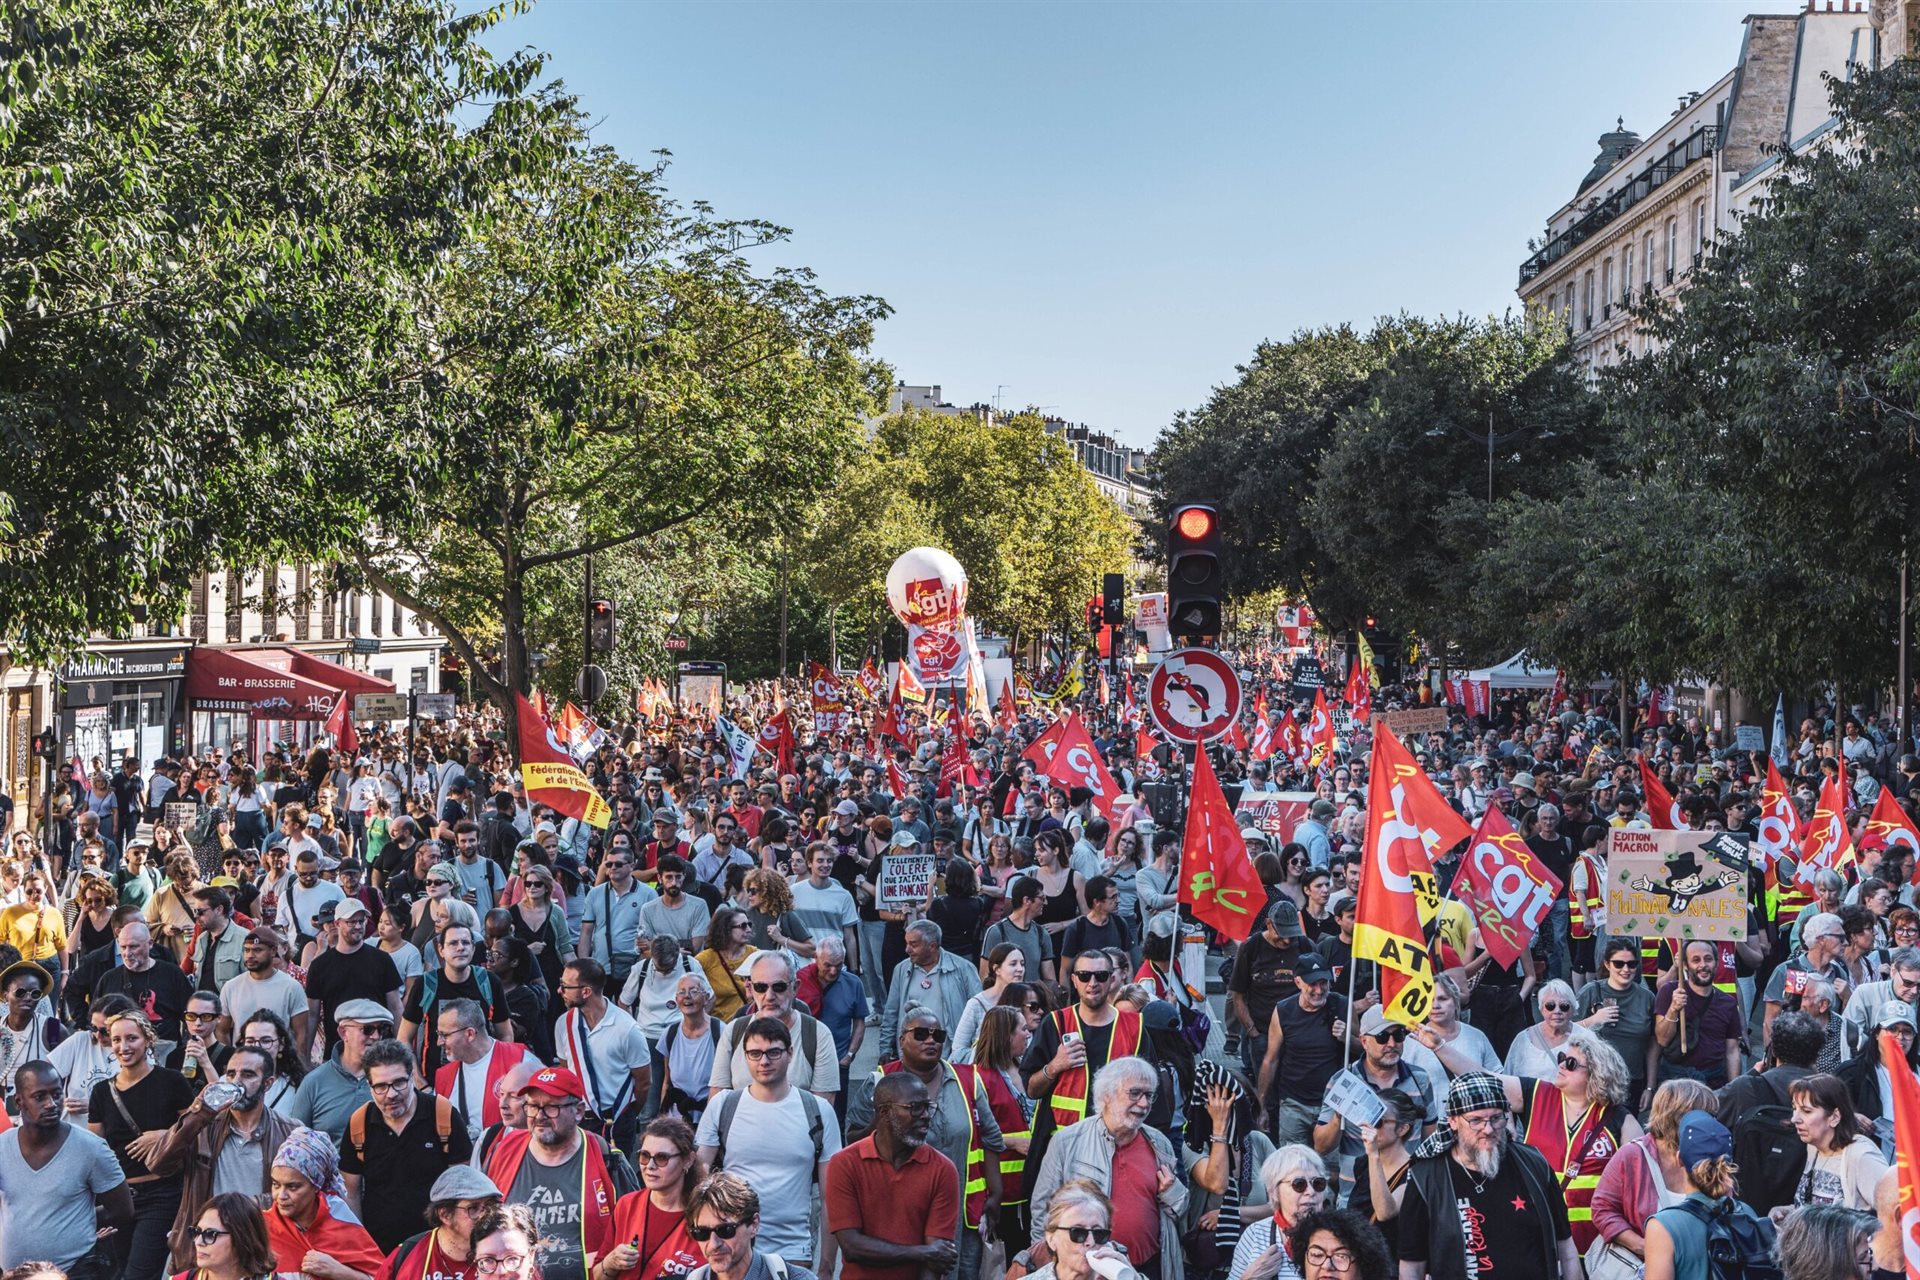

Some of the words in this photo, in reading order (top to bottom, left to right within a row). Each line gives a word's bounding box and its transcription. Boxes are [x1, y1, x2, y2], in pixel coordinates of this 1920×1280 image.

[68, 657, 124, 677] PHARMACIE
[132, 664, 148, 673] CIRQUE
[923, 657, 939, 666] cgt
[218, 677, 237, 687] BAR
[244, 678, 296, 689] BRASSERIE
[196, 699, 246, 710] BRASSERIE
[545, 776, 554, 784] et
[556, 776, 568, 785] de
[1613, 831, 1651, 842] EDITION
[1612, 842, 1659, 853] MACRON
[1719, 834, 1748, 853] ARGENT
[1716, 841, 1744, 860] PUBLIC
[889, 863, 928, 876] COLERE
[884, 875, 897, 884] QUE
[912, 873, 929, 883] FAIT
[883, 884, 898, 898] UNE
[899, 882, 929, 897] PANCART
[1474, 842, 1554, 932] cgt
[1438, 918, 1456, 930] PY
[537, 1072, 557, 1083] cgt
[533, 1202, 582, 1226] HTER
